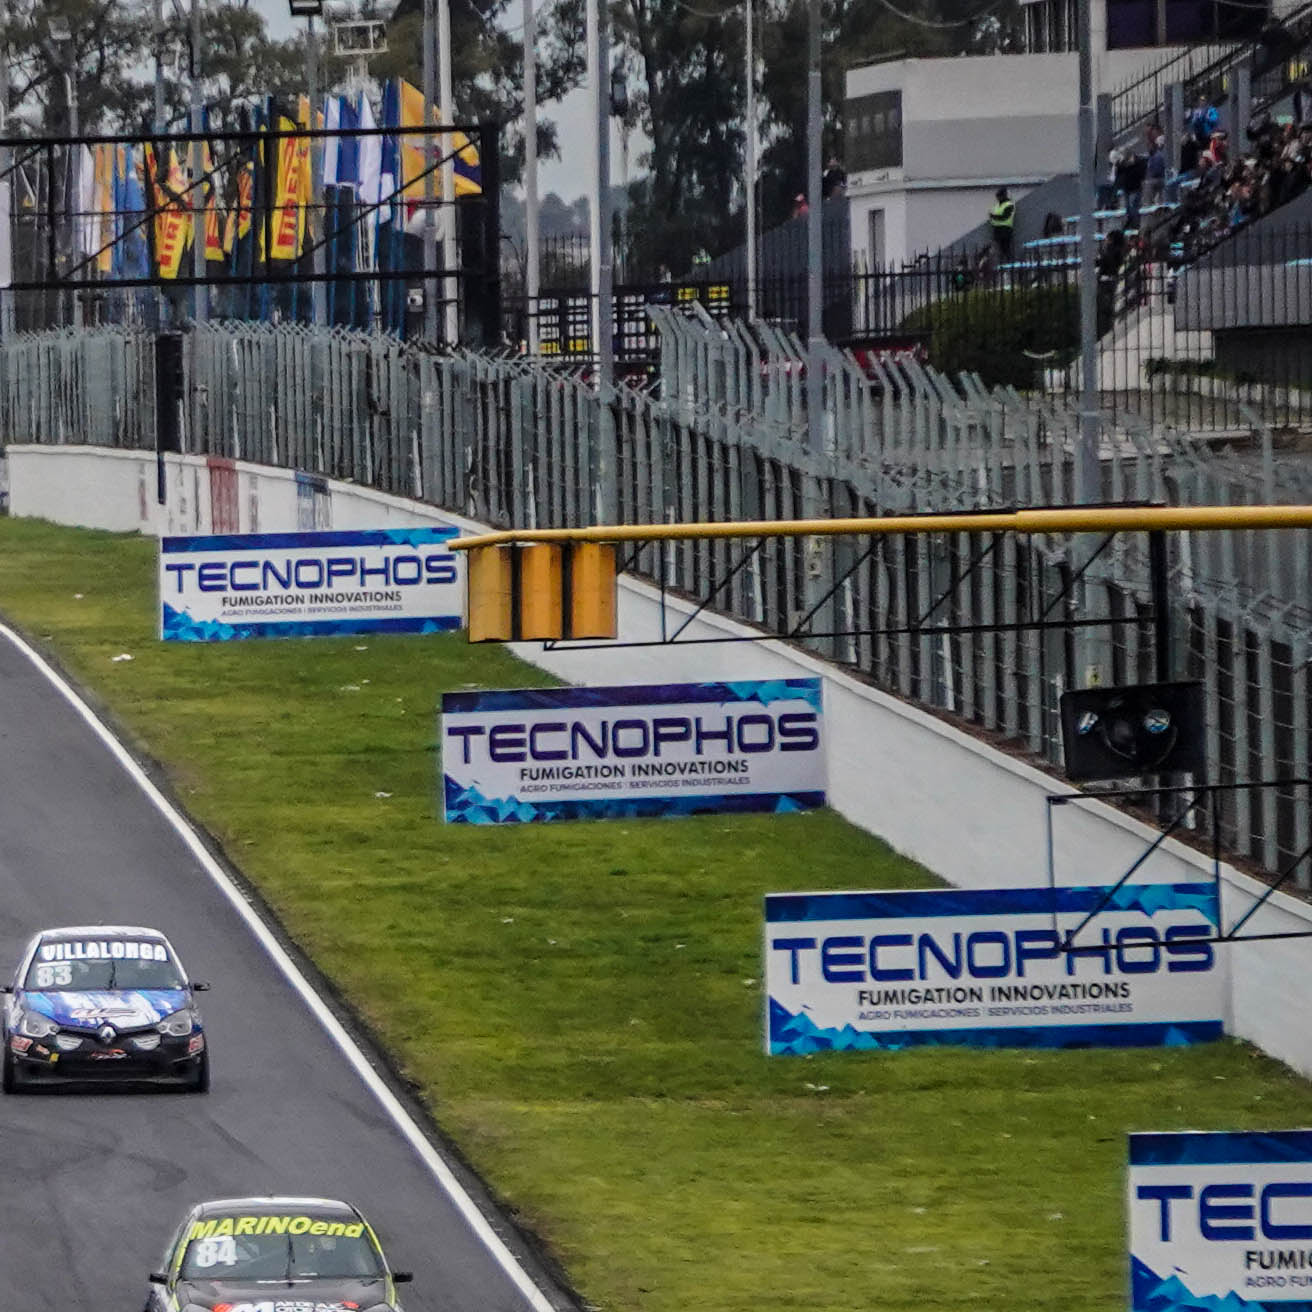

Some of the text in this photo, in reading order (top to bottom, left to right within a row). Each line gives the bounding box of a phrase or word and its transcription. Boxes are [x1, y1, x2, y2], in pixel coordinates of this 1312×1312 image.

[165, 554, 459, 593] TECNOPHOS
[221, 590, 403, 608] FUMIGATION INNOVATIONS
[447, 712, 821, 764] TECNOPHOS
[519, 759, 750, 783] FUMIGATION INNOVATIONS
[40, 941, 169, 962] VILLALONGA
[772, 925, 1216, 985] TECNOPHOS
[36, 965, 74, 987] 83
[857, 982, 1131, 1007] FUMIGATION INNOVATIONS
[196, 1239, 238, 1268] 84
[1244, 1276, 1287, 1288] AGRO
